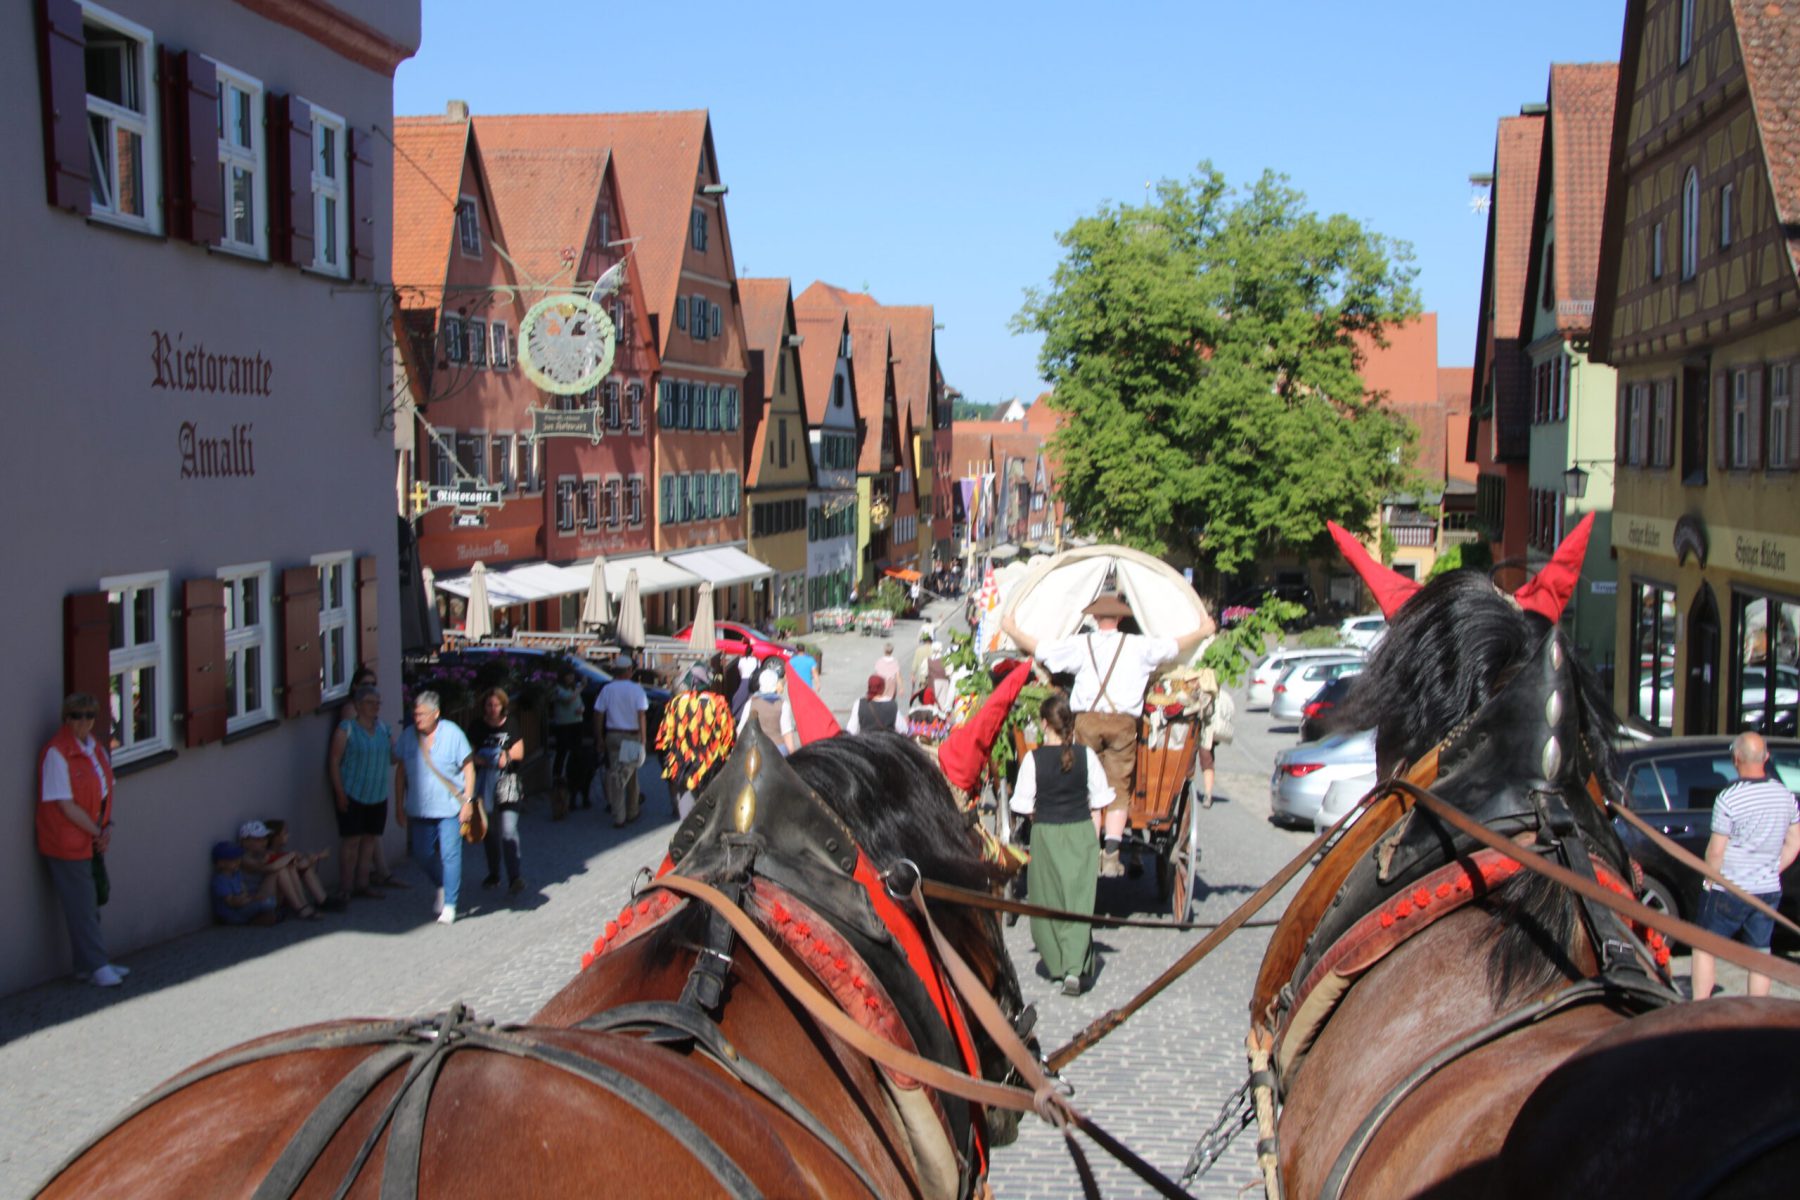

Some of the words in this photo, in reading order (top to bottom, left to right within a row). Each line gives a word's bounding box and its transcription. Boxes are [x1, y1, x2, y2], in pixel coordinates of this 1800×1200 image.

[151, 330, 273, 397] Ristorante
[178, 420, 255, 480] Amalfi
[437, 489, 492, 503] Ristorante
